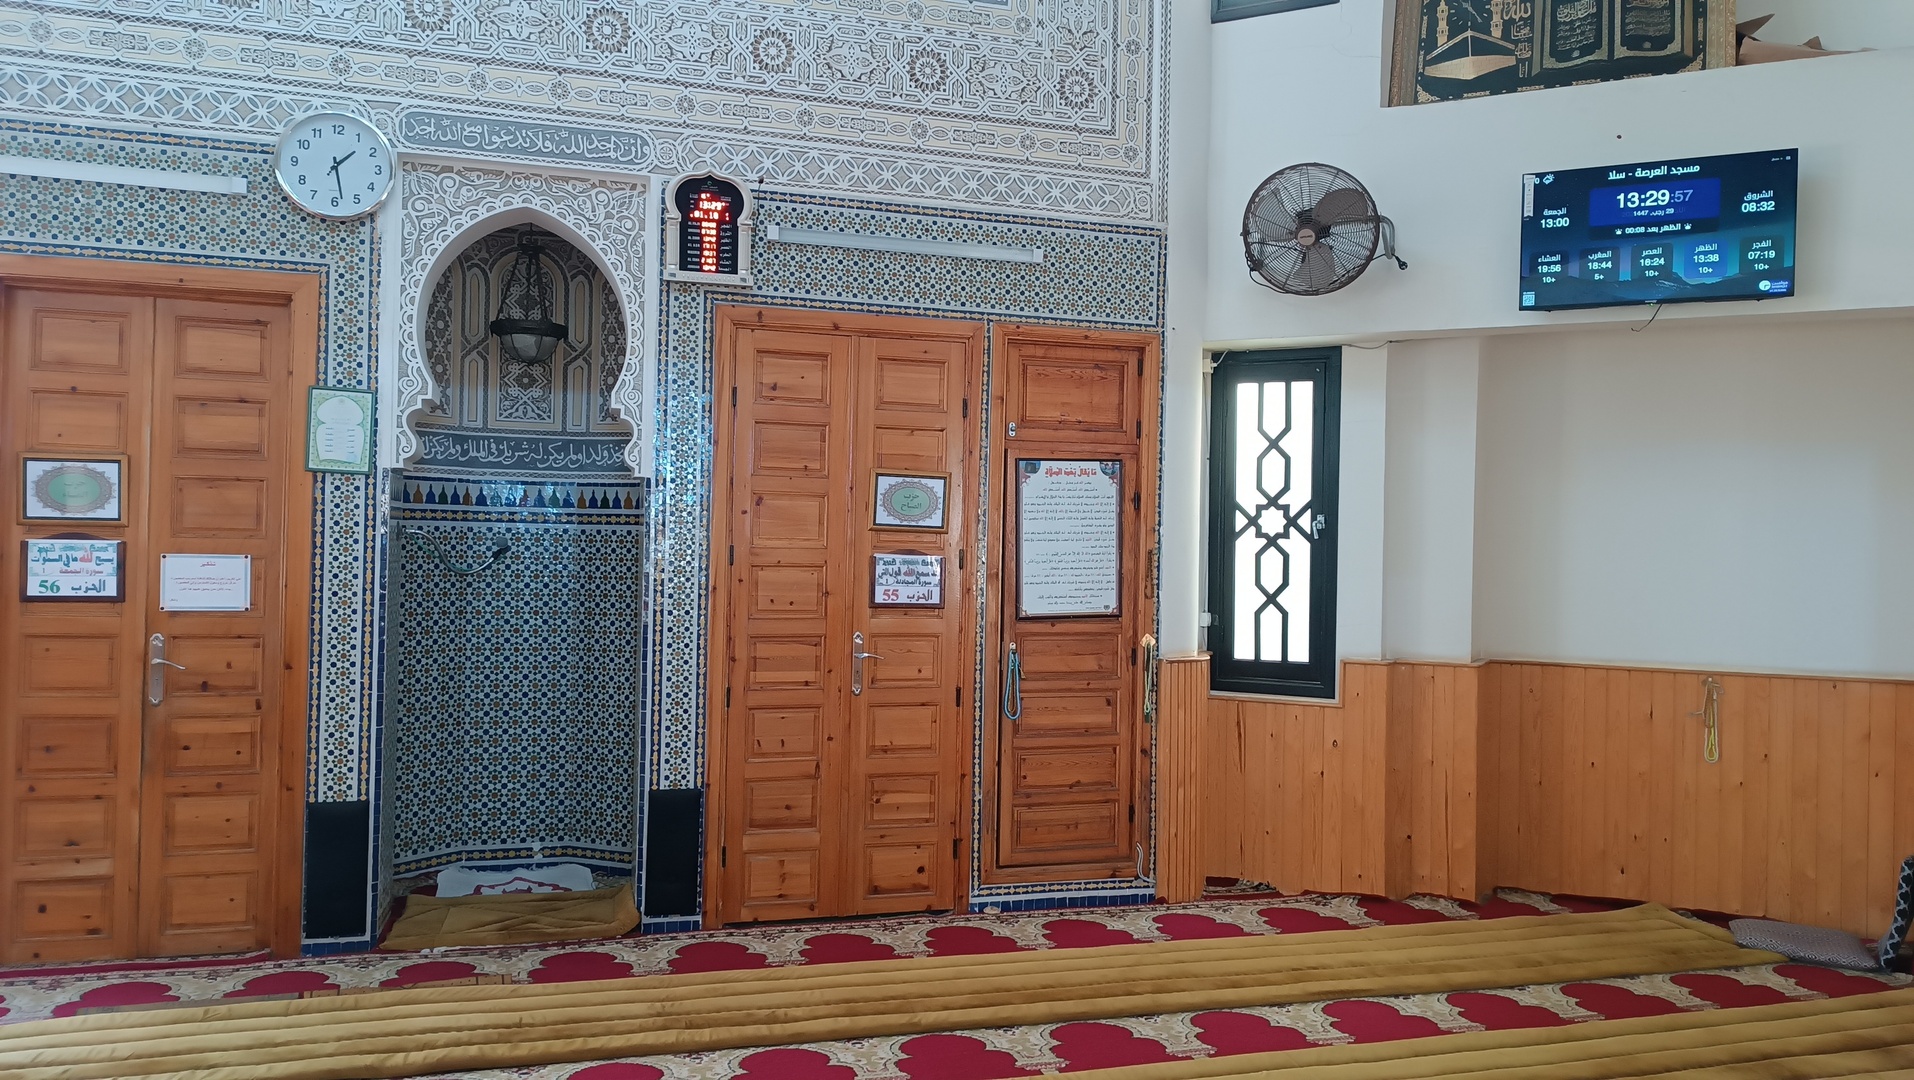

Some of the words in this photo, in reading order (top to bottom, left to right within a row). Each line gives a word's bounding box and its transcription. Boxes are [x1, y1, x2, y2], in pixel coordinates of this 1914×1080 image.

[311, 128, 322, 138] 11
[332, 124, 345, 135] 12
[355, 133, 361, 143] 1
[297, 139, 310, 150] 10
[369, 147, 377, 158] 2
[290, 156, 299, 166] 9
[374, 165, 382, 175] 3
[1635, 166, 1667, 178] العرصة
[1670, 165, 1700, 176] مسجد
[298, 175, 306, 185] 8
[1608, 171, 1625, 180] سلا
[367, 182, 375, 192] 4
[310, 190, 318, 200] 7
[353, 194, 361, 204] 5
[1744, 190, 1773, 201] الشروق
[331, 197, 339, 207] 6
[1741, 201, 1775, 212] 08:32
[1543, 207, 1567, 216] الجمعة
[1540, 217, 1570, 228] 13:00
[1625, 226, 1645, 234] 00:08
[1646, 226, 1658, 234] بعد
[1660, 223, 1681, 233] الظهر
[1694, 243, 1718, 253] الظهر
[1752, 240, 1772, 250] الفجر
[1588, 251, 1612, 260] المغرب
[1641, 247, 1662, 257] العصر
[1747, 250, 1776, 260] 07:19
[1538, 254, 1561, 263] العشاء
[1693, 254, 1720, 263] 13:38
[1537, 264, 1562, 273] 19:56
[1587, 261, 1613, 270] 18:44
[38, 579, 61, 594] 56
[71, 579, 105, 594] الحزب
[882, 589, 900, 601] 55
[907, 589, 933, 602] الحزب
